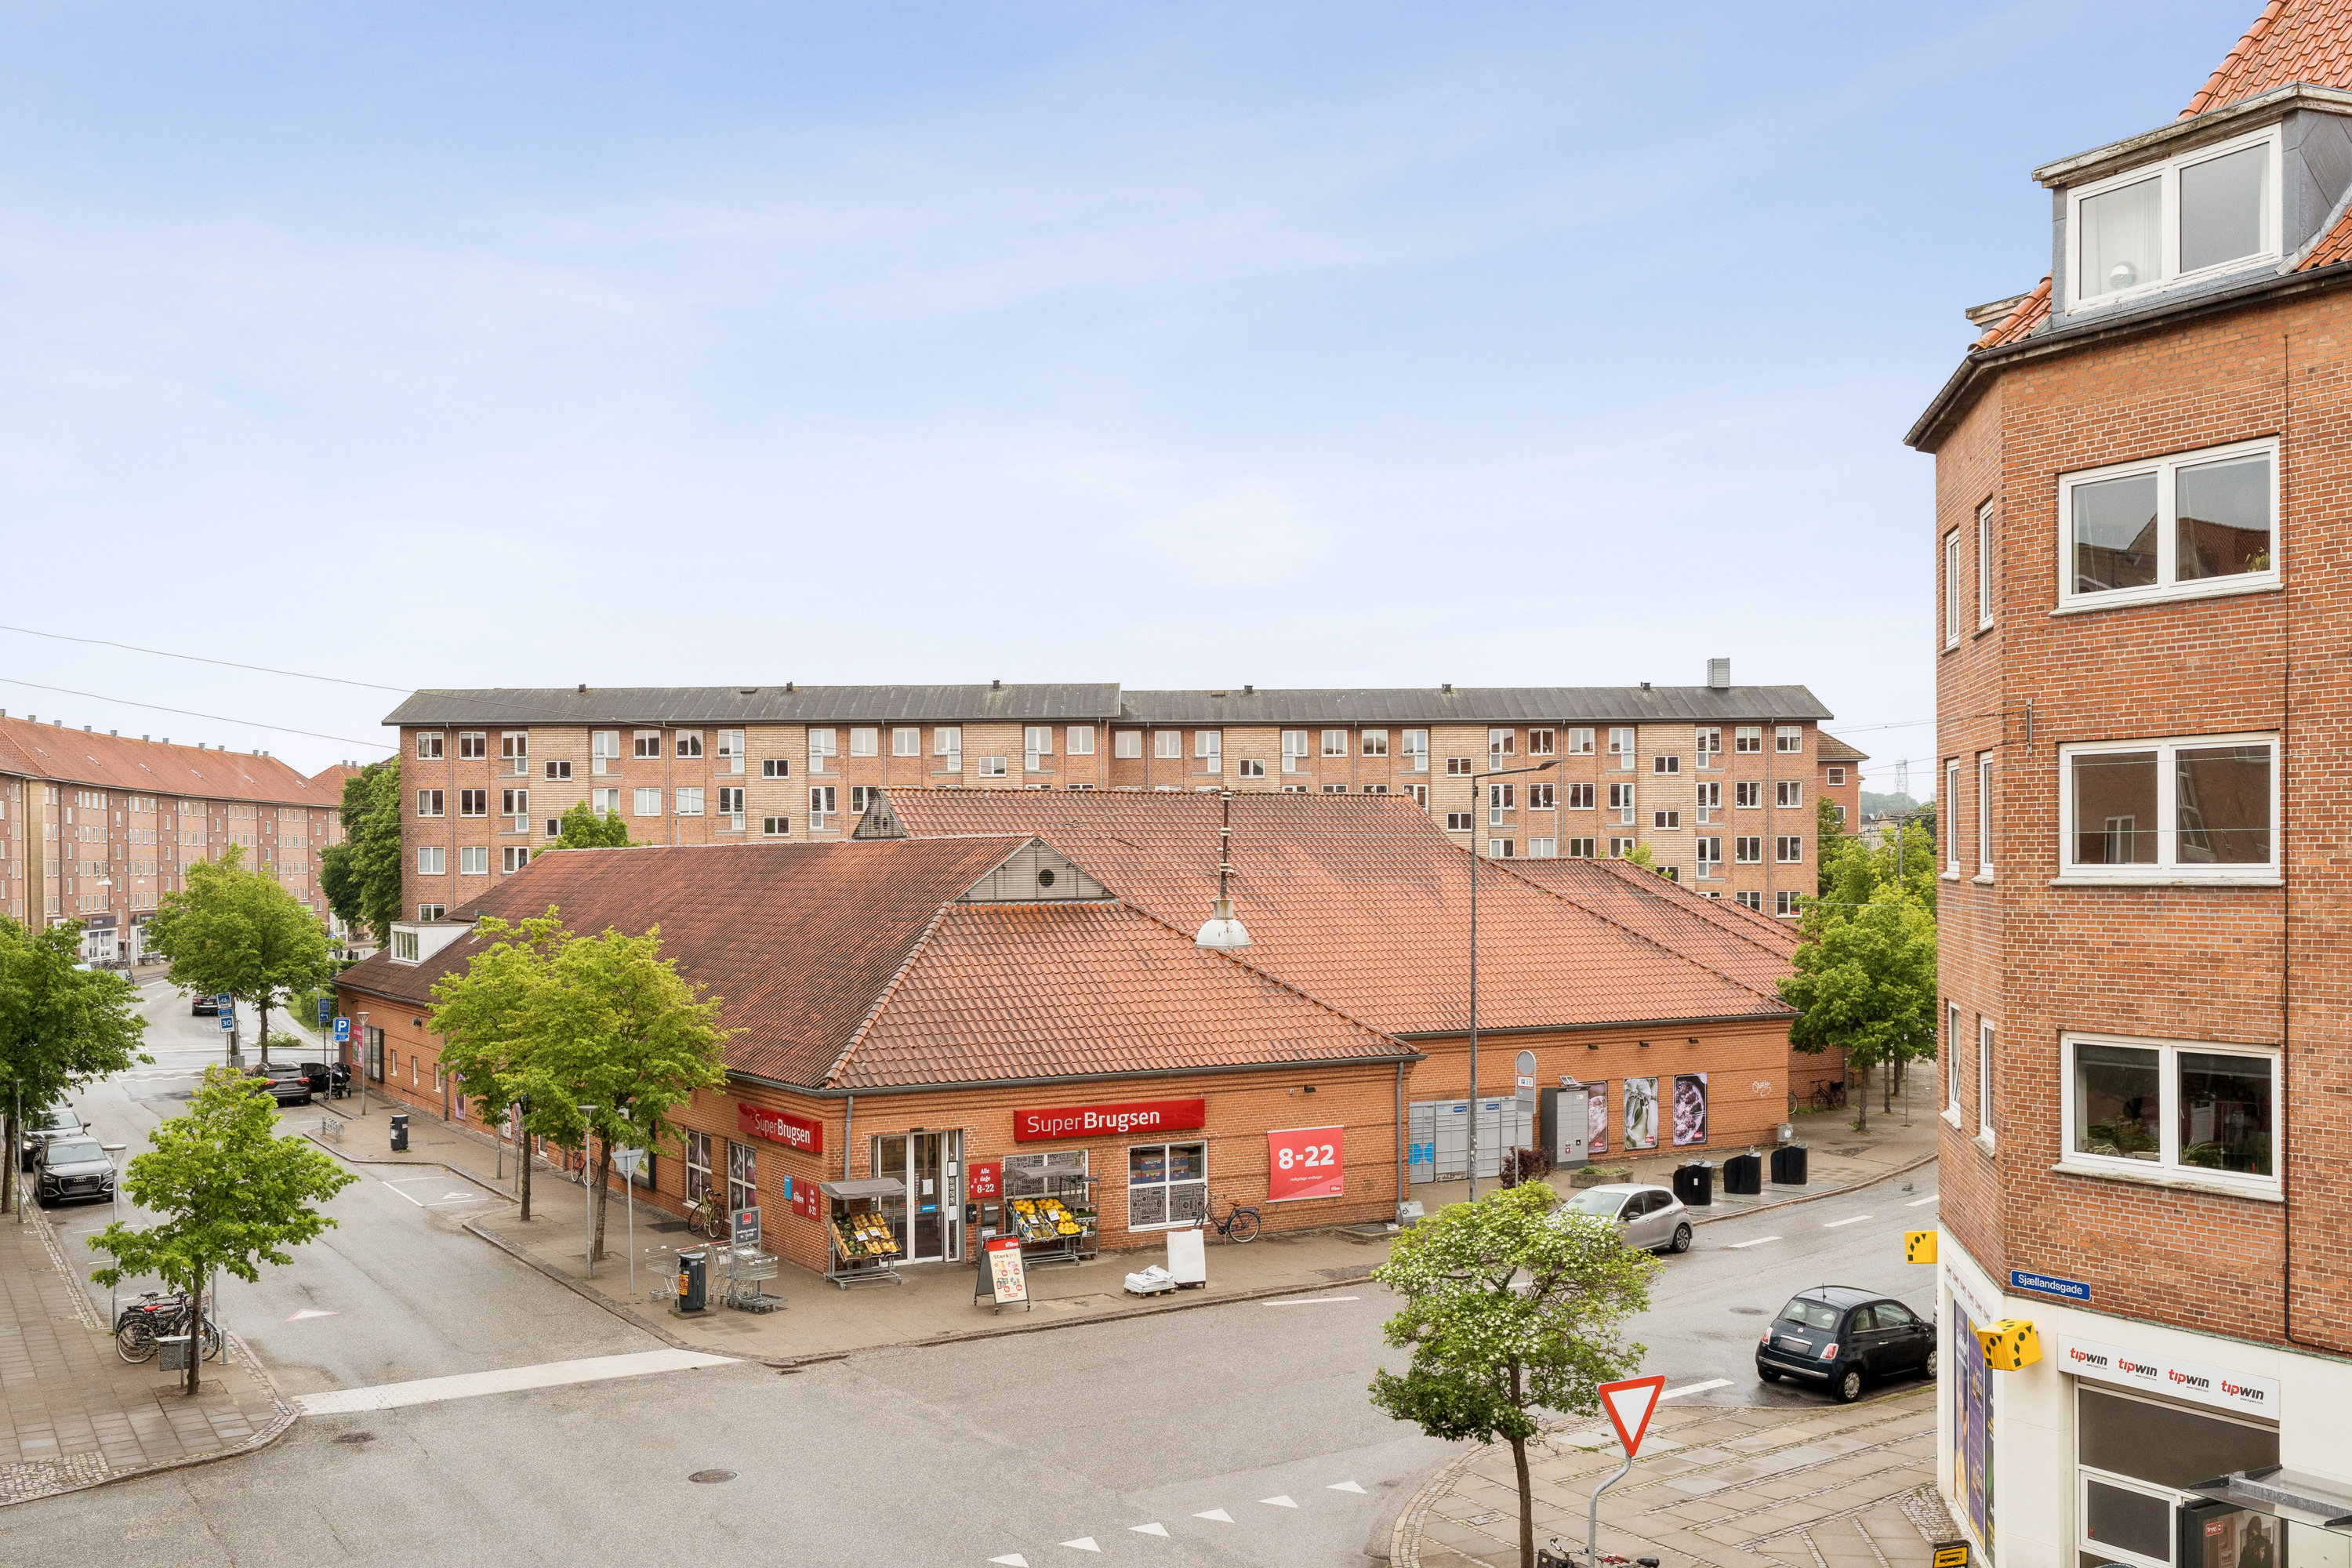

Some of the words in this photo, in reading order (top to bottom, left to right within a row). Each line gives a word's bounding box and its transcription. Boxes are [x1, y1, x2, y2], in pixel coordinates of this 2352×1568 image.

[338, 1020, 347, 1032] P
[755, 1113, 811, 1145] SuperBrugsen
[1027, 1110, 1160, 1136] SuperBrugsen
[1278, 1145, 1334, 1170] 8-22
[977, 1183, 995, 1193] 8-22
[808, 1204, 817, 1215] 8-22
[2018, 1274, 2083, 1295] Sjællandsgade
[2070, 1348, 2107, 1366] tipwin
[2118, 1358, 2158, 1377] tipwin
[2169, 1369, 2209, 1388] tipwin
[2221, 1380, 2264, 1400] tipwin
